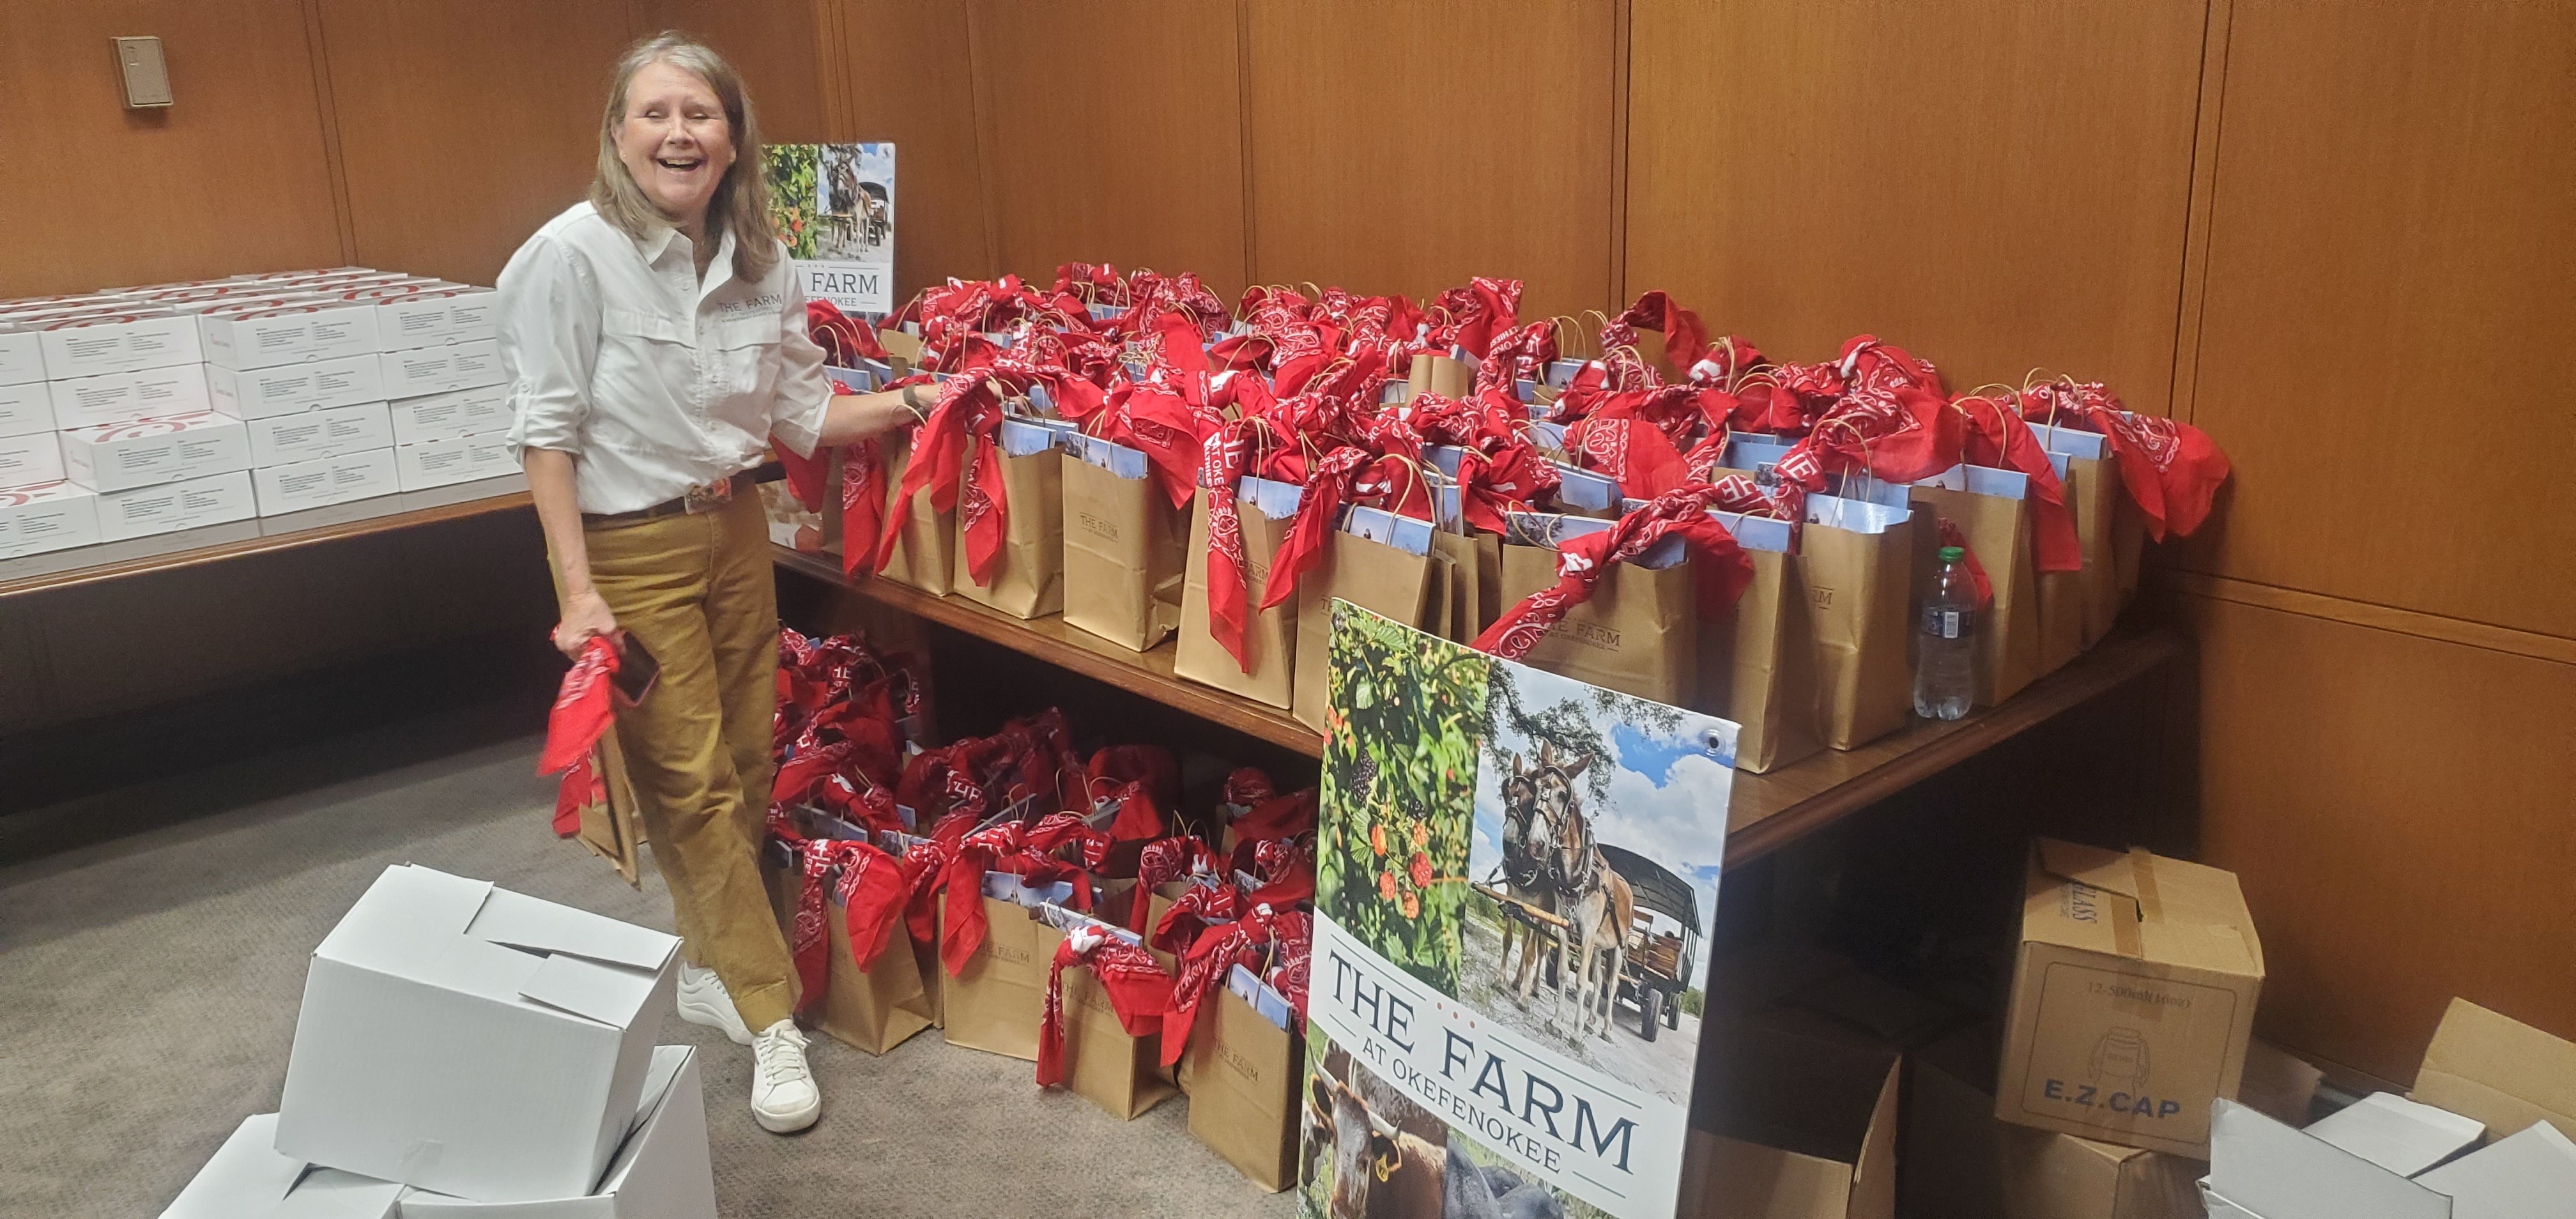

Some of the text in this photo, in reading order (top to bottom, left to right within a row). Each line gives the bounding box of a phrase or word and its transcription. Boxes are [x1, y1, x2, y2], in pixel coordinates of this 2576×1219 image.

[811, 272, 878, 295] FARM
[716, 295, 782, 312] THE FARM
[1080, 515, 1096, 529] THE
[1099, 521, 1119, 539] FARM
[1248, 564, 1268, 580] ARM
[1575, 623, 1621, 647] FARM
[1329, 949, 1640, 1176] THE FARM
[1363, 1036, 1561, 1174] AT OKEFENOKEE
[2044, 1078, 2181, 1119] E.Z.CAP
